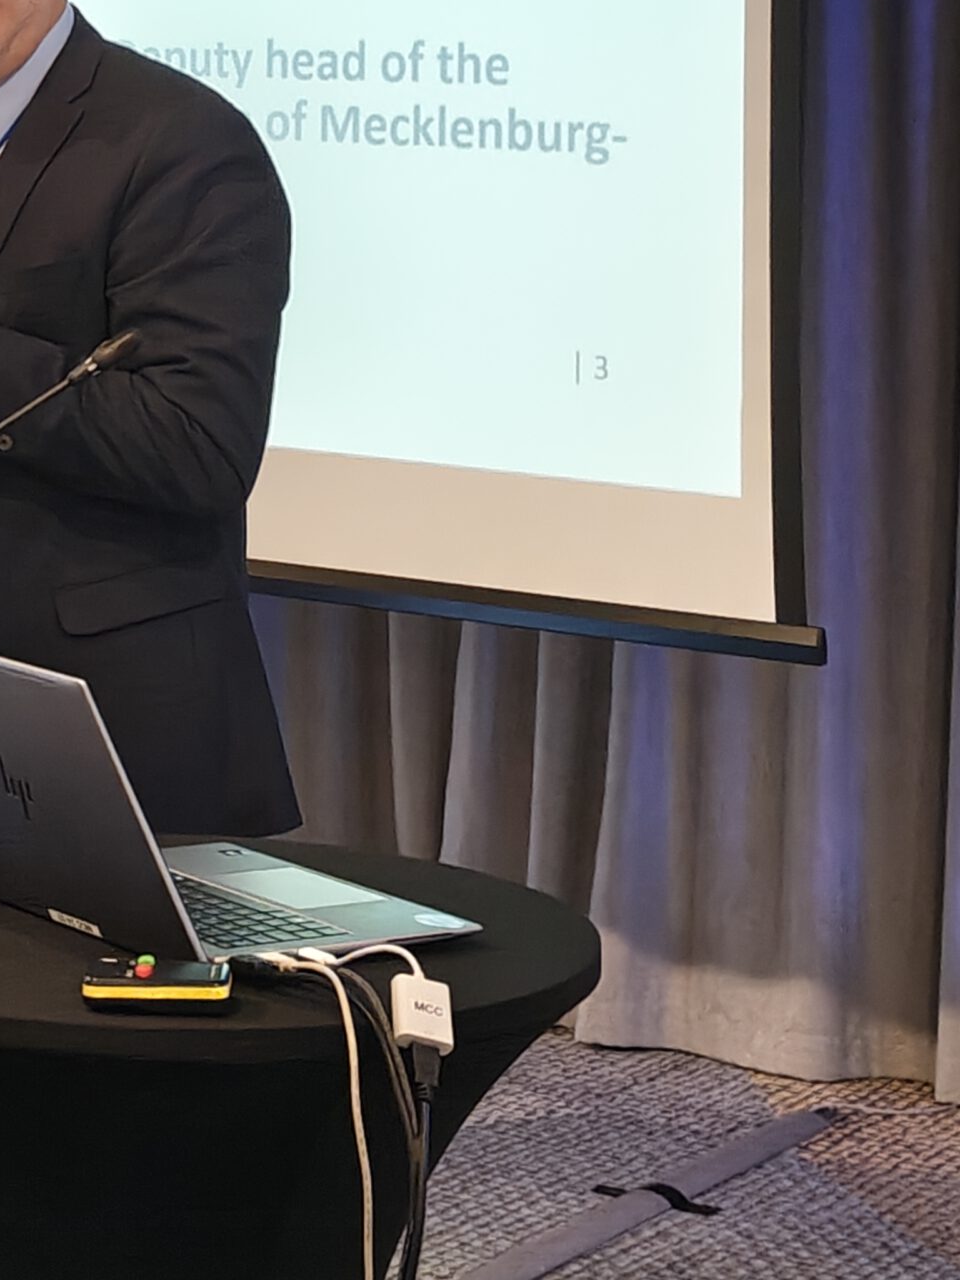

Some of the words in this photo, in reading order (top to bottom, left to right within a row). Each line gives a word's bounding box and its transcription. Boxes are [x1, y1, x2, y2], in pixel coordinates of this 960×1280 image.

[266, 38, 367, 82] head
[380, 39, 427, 83] of
[436, 41, 510, 86] the
[266, 98, 309, 142] of
[320, 103, 628, 166] Mecklenburg-
[594, 355, 609, 381] 3
